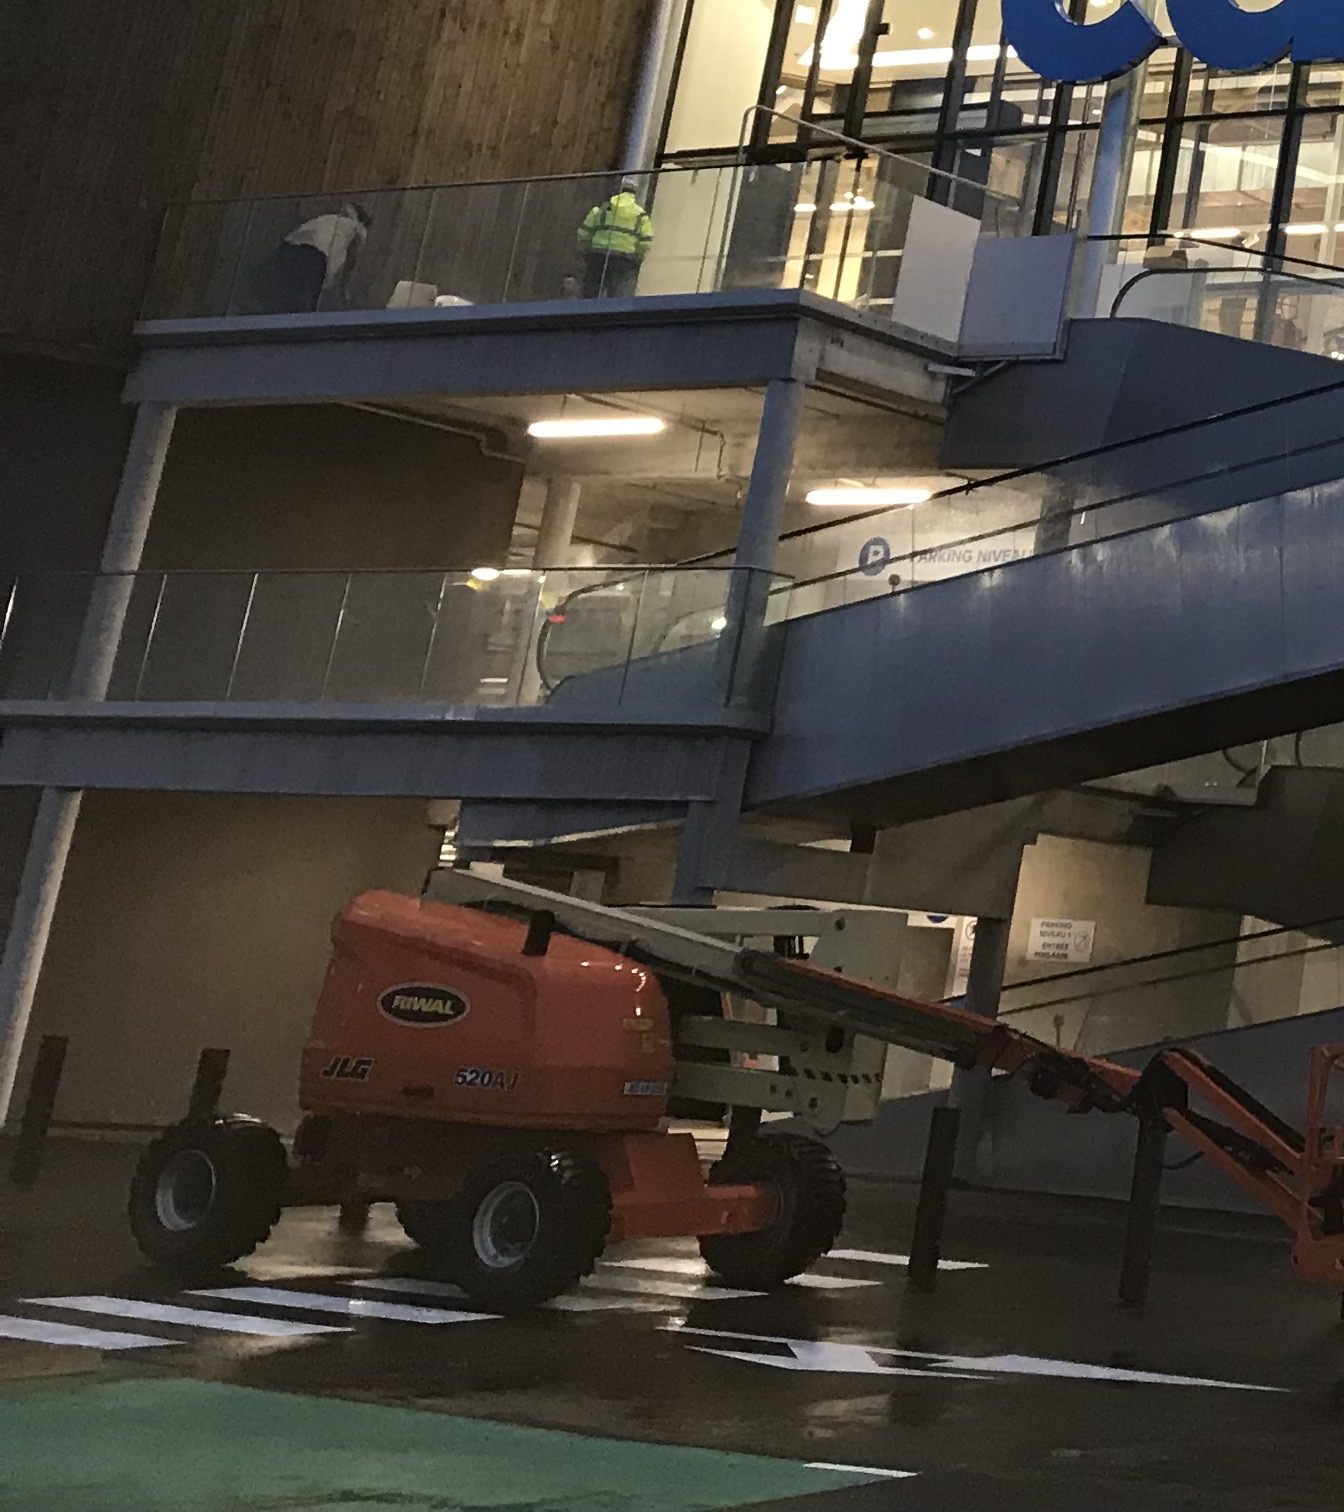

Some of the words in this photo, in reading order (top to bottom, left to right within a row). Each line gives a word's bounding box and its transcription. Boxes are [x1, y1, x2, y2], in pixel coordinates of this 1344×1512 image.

[910, 549, 973, 563] ARKING
[392, 995, 454, 1016] RIWAL
[320, 1056, 375, 1081] JLG
[455, 1068, 519, 1090] 520AJ
